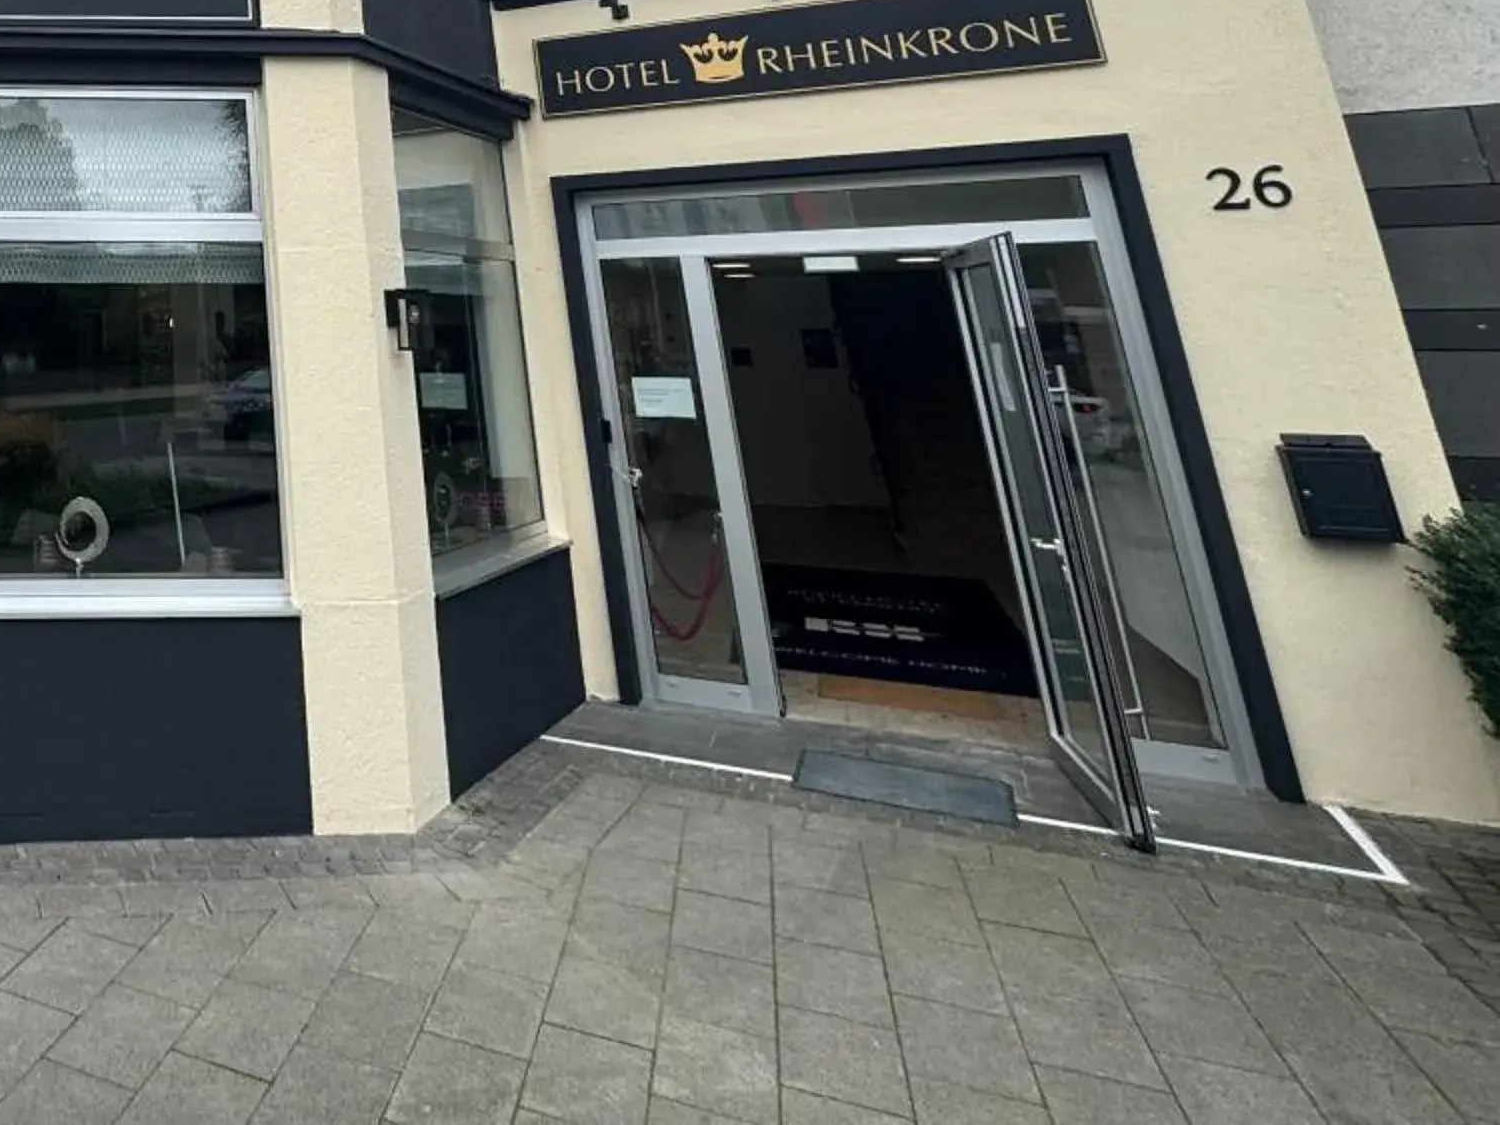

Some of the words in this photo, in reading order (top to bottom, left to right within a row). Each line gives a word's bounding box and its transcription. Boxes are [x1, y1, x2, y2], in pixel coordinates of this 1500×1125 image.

[556, 60, 679, 96] HOTEL
[756, 12, 1073, 75] RHEINKRONE
[1205, 164, 1293, 211] 26
